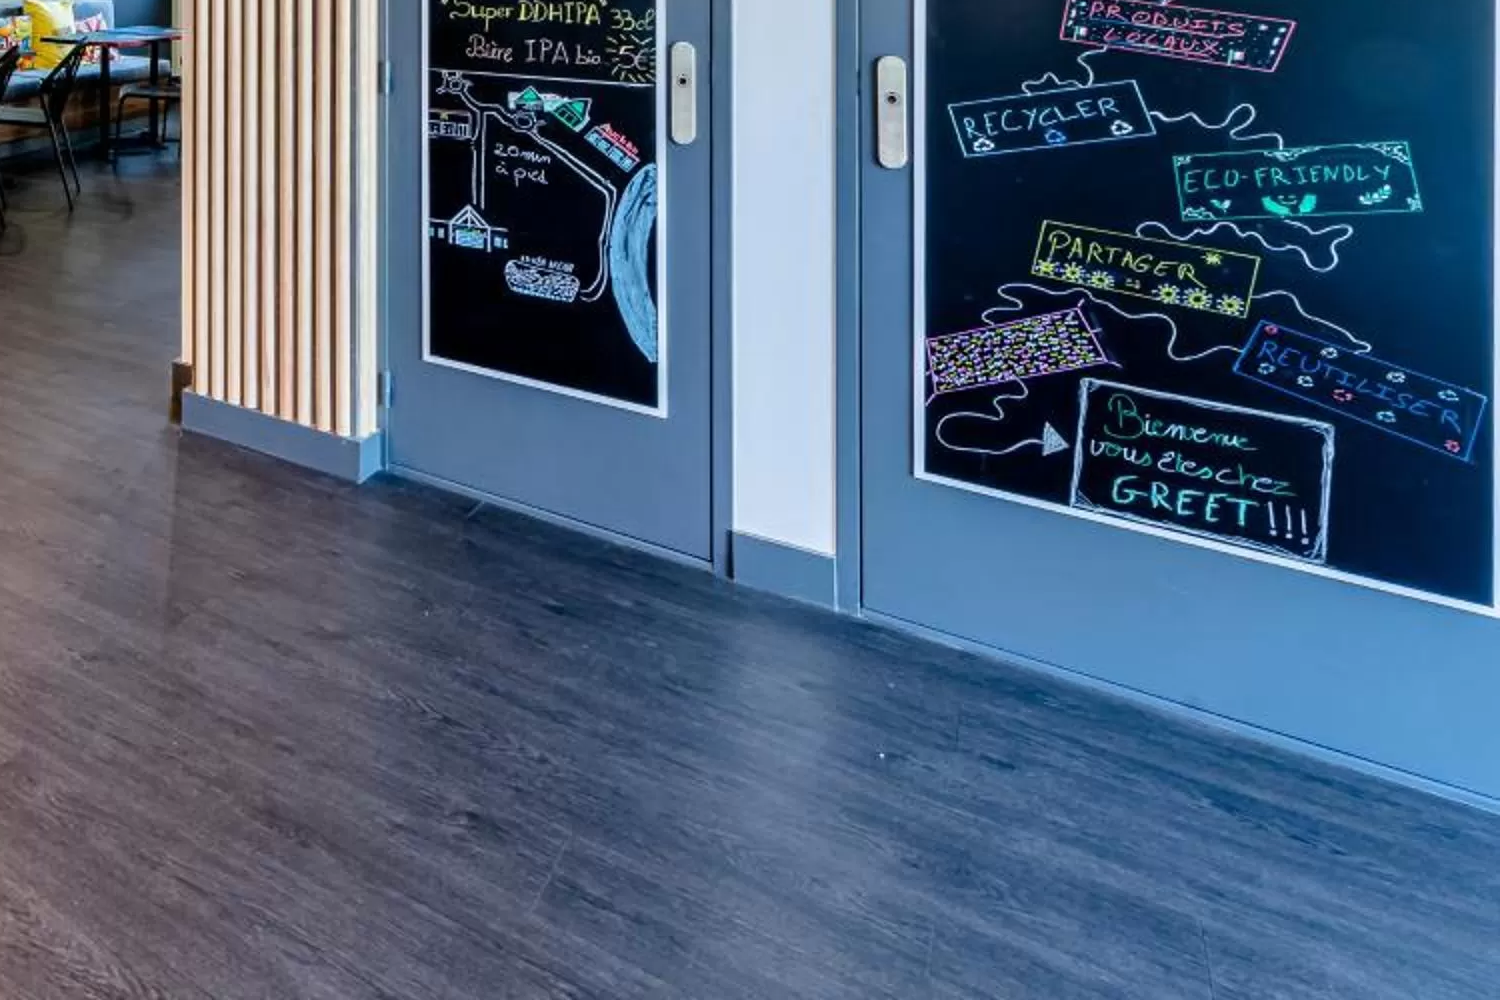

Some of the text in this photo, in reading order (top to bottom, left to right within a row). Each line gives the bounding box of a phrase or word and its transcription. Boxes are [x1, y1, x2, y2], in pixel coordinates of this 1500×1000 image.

[1087, 0, 1245, 37] PRODUITS
[466, 33, 513, 63] Bière
[524, 37, 569, 65] IPA
[575, 45, 602, 66] bio
[1102, 26, 1220, 56] LOCAUX
[962, 96, 1120, 140] RECYCLER
[1047, 230, 1208, 289] PARTAGER
[1111, 475, 1261, 528] GREET
